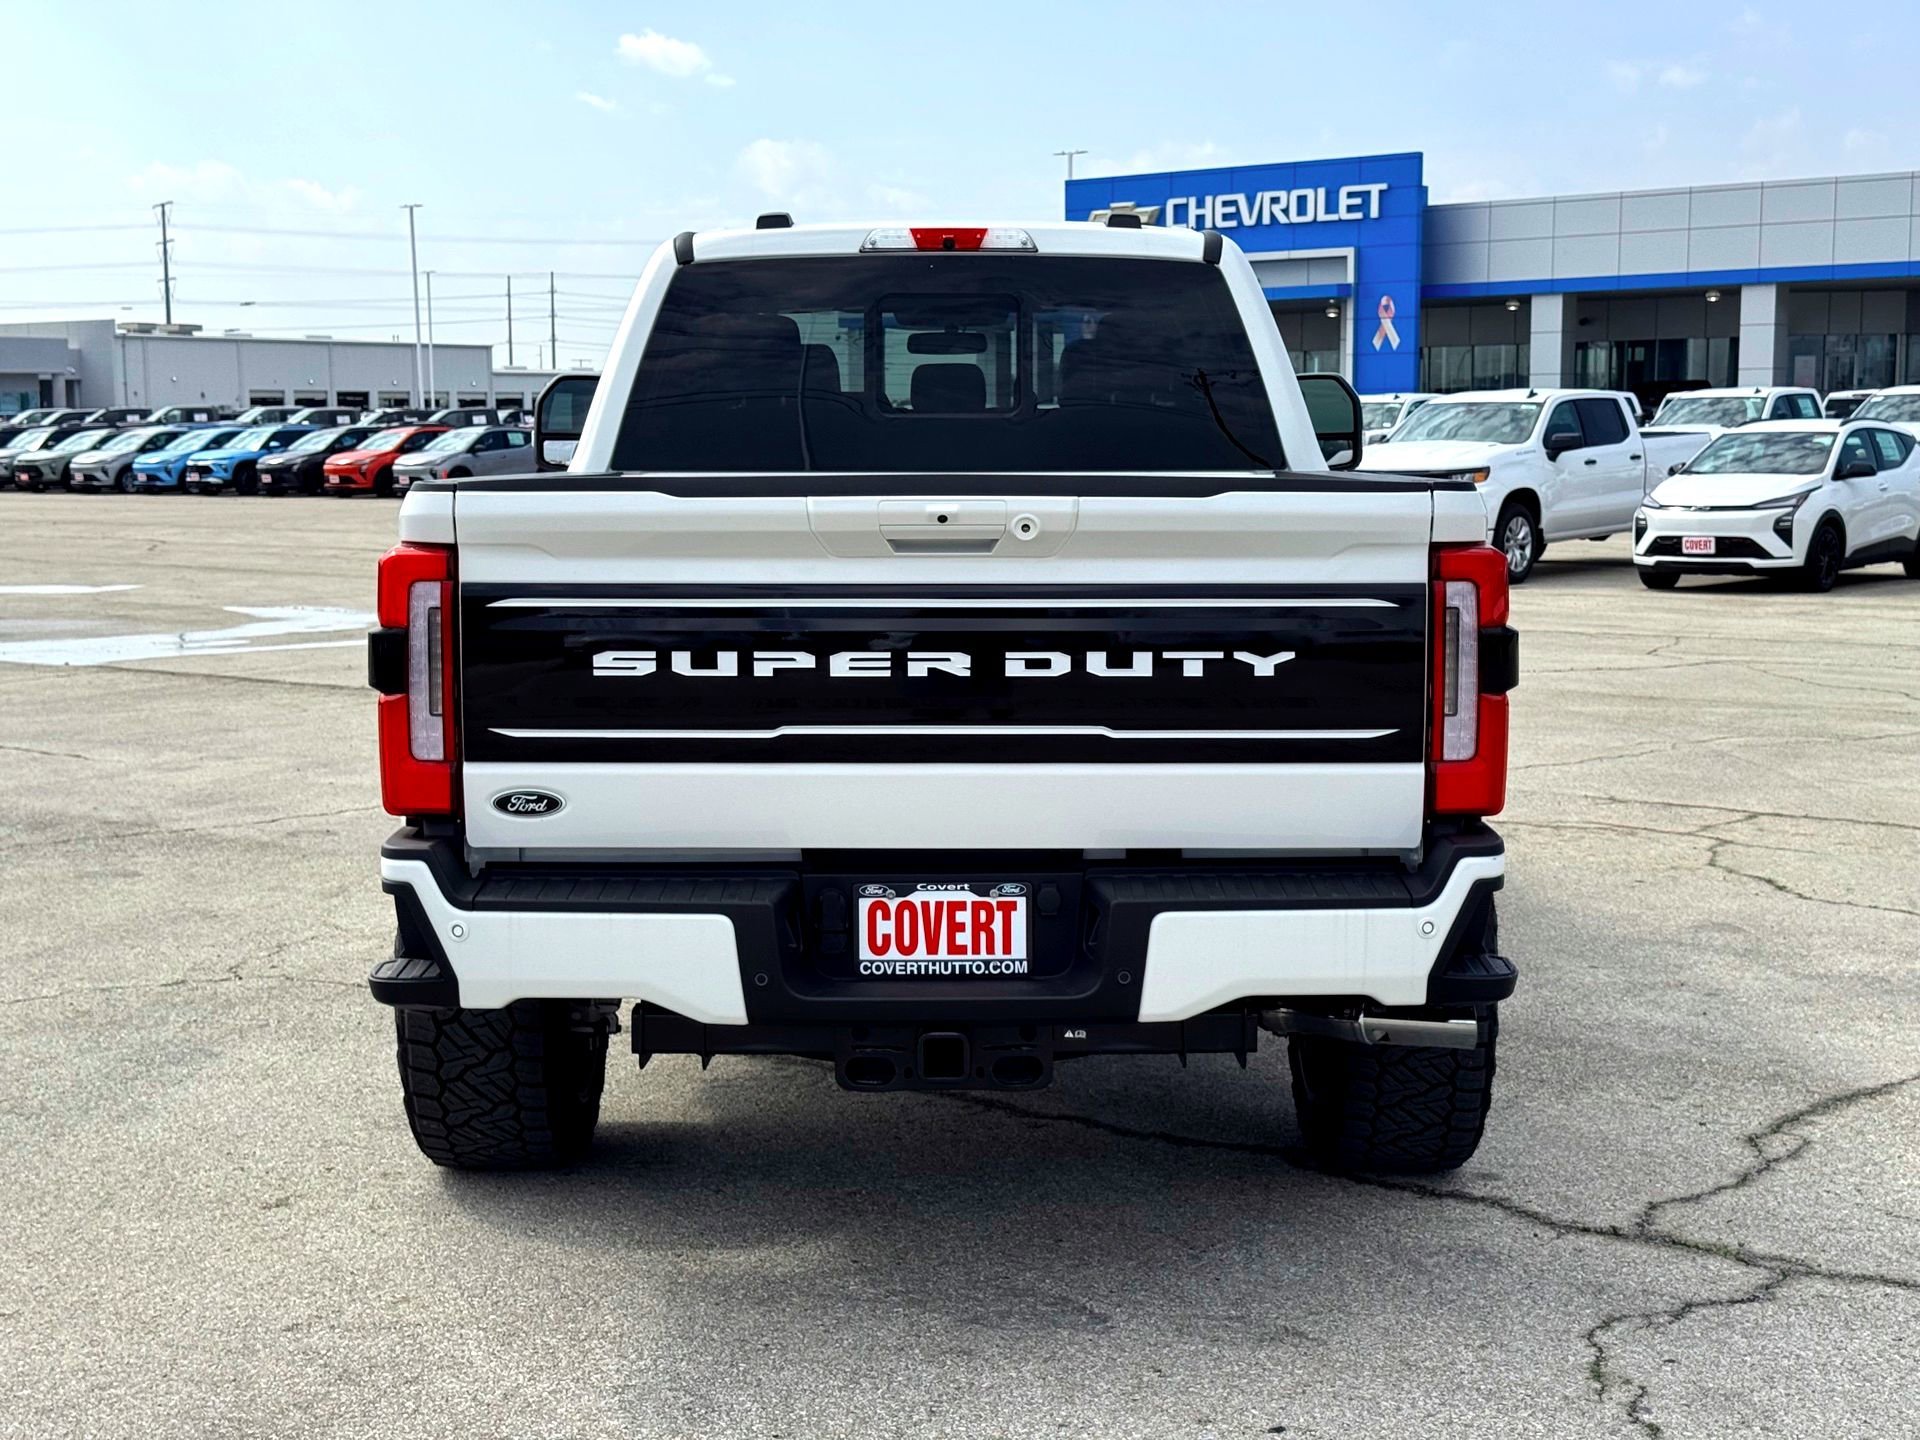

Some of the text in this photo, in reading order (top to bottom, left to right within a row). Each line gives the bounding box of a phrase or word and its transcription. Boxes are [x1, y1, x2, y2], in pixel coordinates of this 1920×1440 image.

[1165, 182, 1389, 229] CHEVROLET
[1684, 539, 1713, 551] COVERT
[592, 650, 1296, 677] SUPER DUTY
[507, 794, 548, 812] Ford
[916, 883, 970, 891] Covert
[867, 899, 1018, 957] COVERT
[859, 961, 1028, 975] COVERTHUTTO.COM
